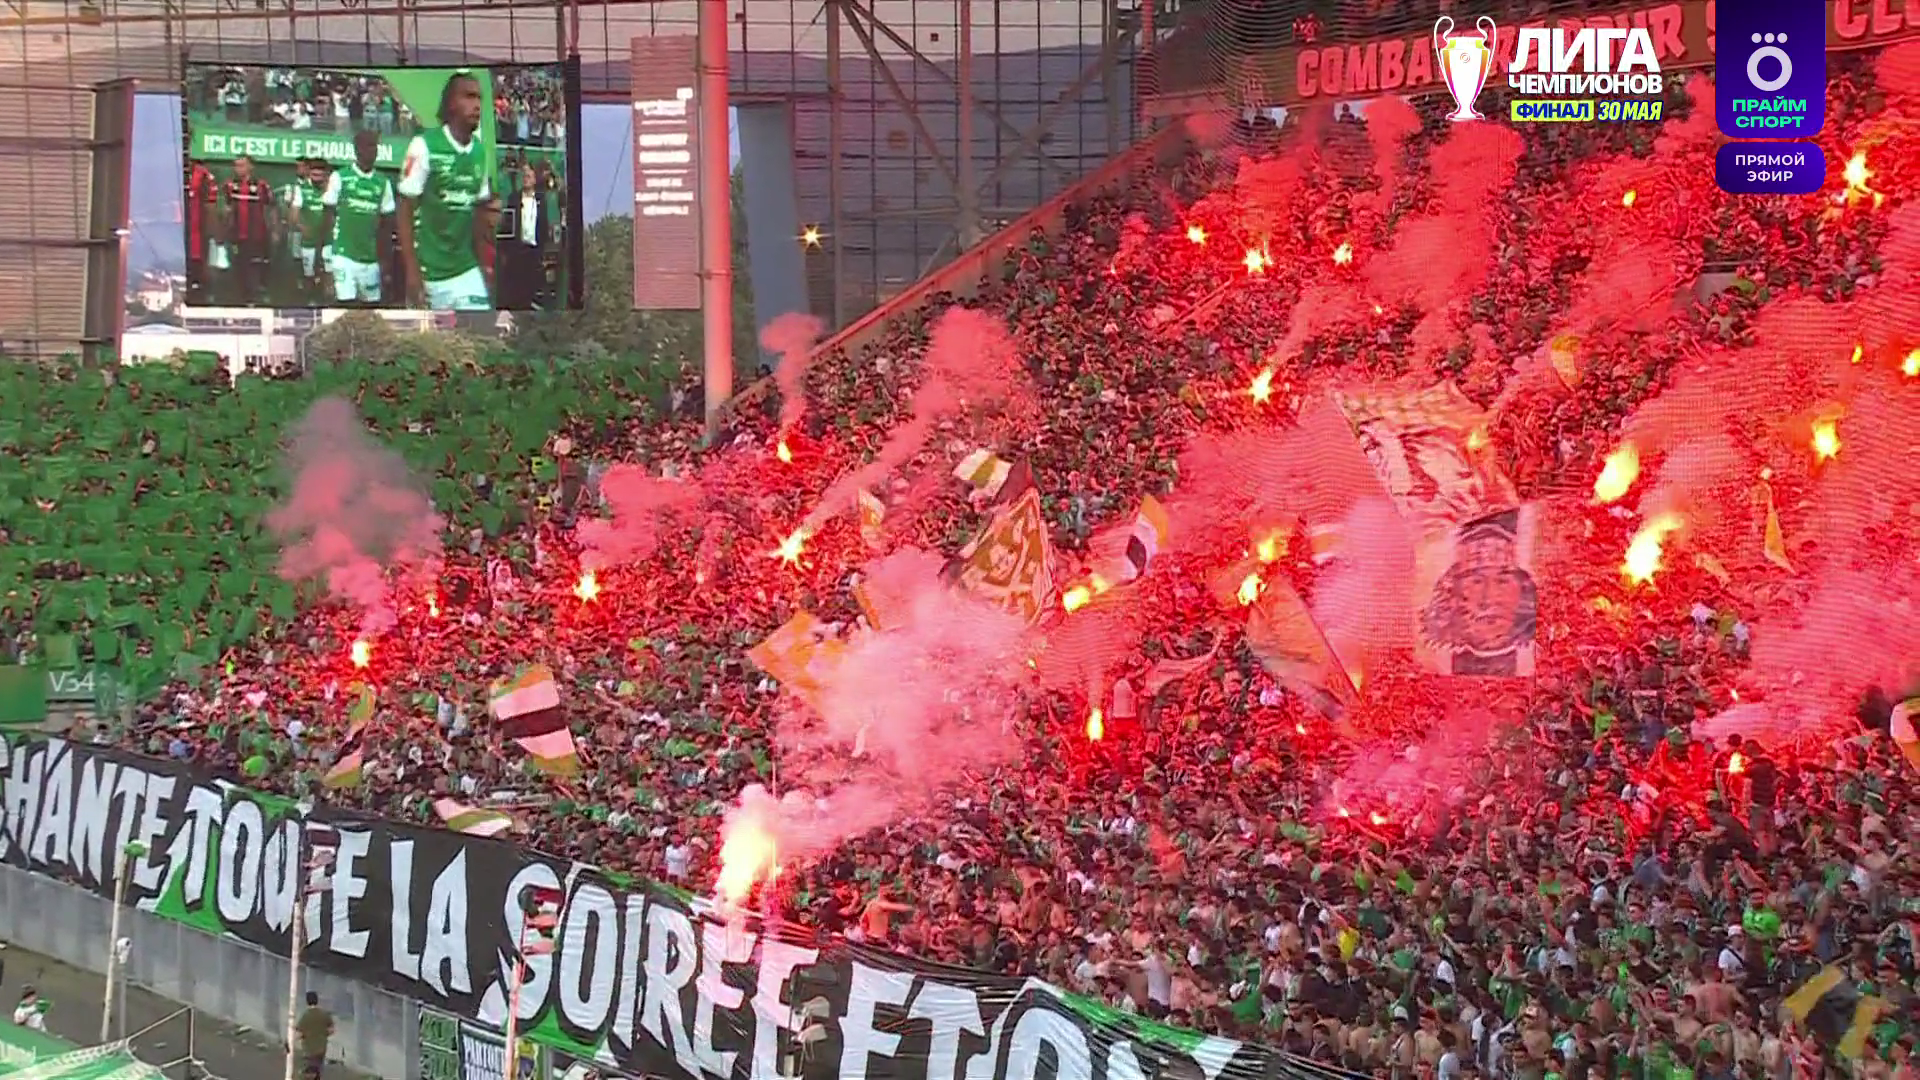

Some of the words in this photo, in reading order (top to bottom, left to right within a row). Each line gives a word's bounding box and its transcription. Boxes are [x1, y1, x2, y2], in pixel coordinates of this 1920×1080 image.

[204, 135, 226, 153] ICI
[230, 136, 278, 156] C'EST
[282, 138, 301, 157] LE
[390, 839, 472, 997] LA
[838, 960, 986, 1080] ET
